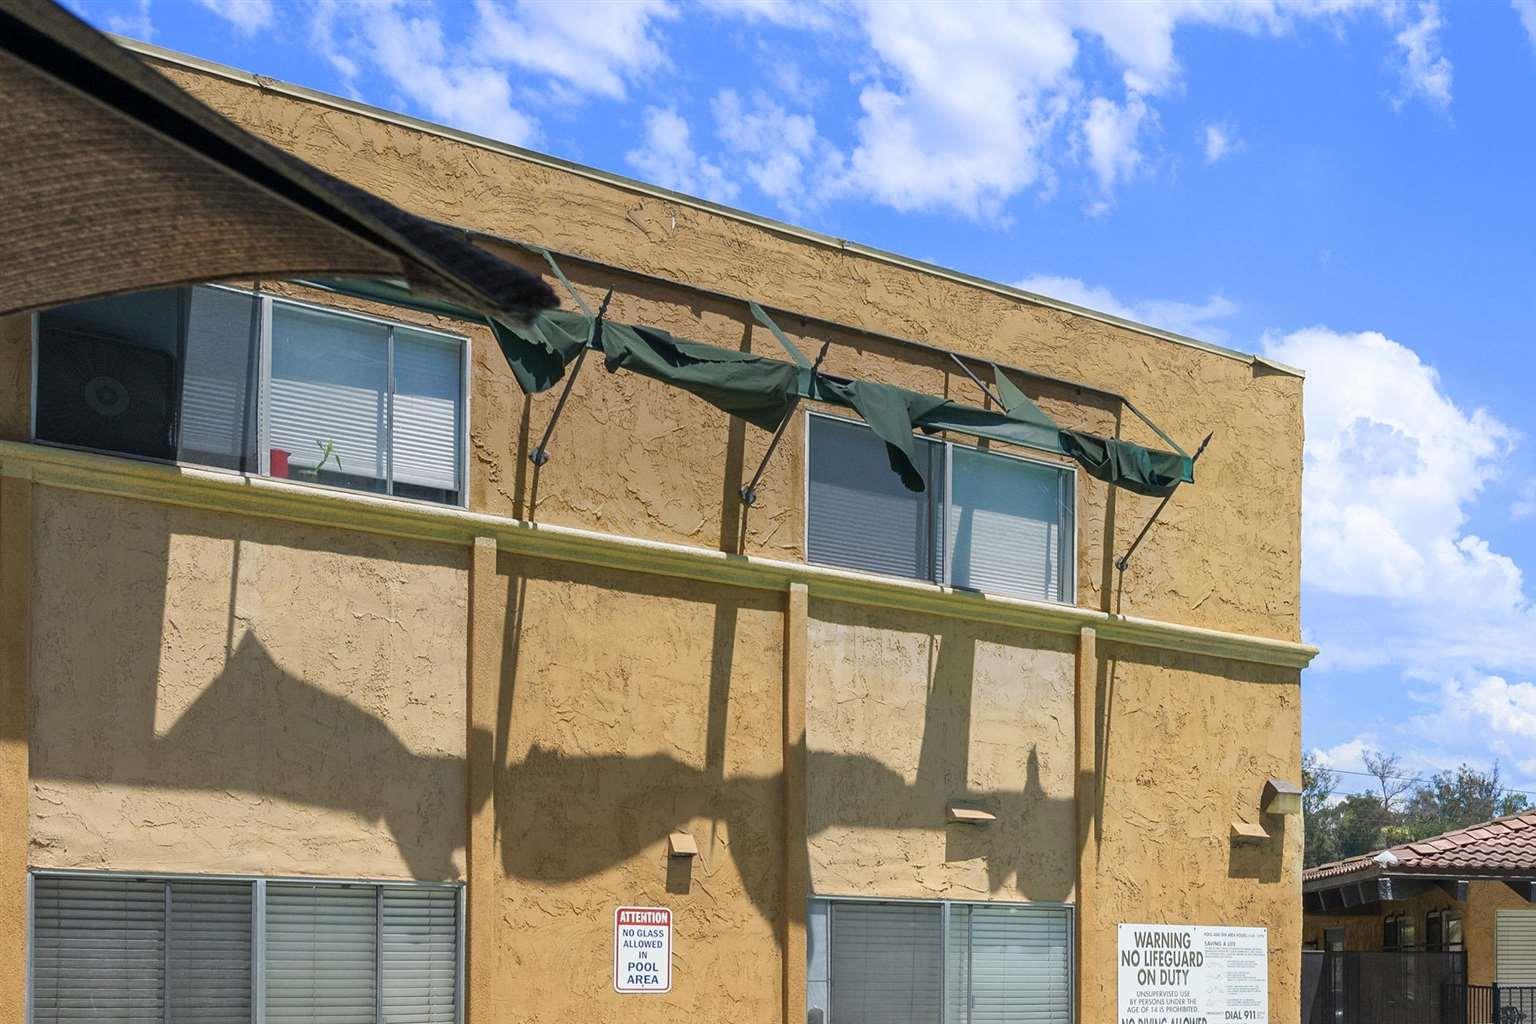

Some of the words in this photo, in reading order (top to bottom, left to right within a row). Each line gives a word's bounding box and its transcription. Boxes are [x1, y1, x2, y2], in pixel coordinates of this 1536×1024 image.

[620, 911, 668, 924] ATTENTION
[623, 929, 635, 937] NO
[637, 929, 664, 938] GLASS
[623, 940, 663, 949] ALLOWED
[1134, 931, 1191, 949] WARNING
[638, 951, 648, 959] IN
[1121, 949, 1140, 967] NO
[1144, 950, 1204, 968] LIFEGUARD
[627, 962, 659, 972] POOL
[627, 974, 659, 985] AREA
[1137, 968, 1156, 986] ON
[1160, 969, 1190, 986] DUTY
[1136, 990, 1179, 998] UNSUPERVISED
[1138, 998, 1165, 1006] PERSONS
[1225, 1010, 1242, 1020] DIAL
[1244, 1010, 1256, 1020] 911
